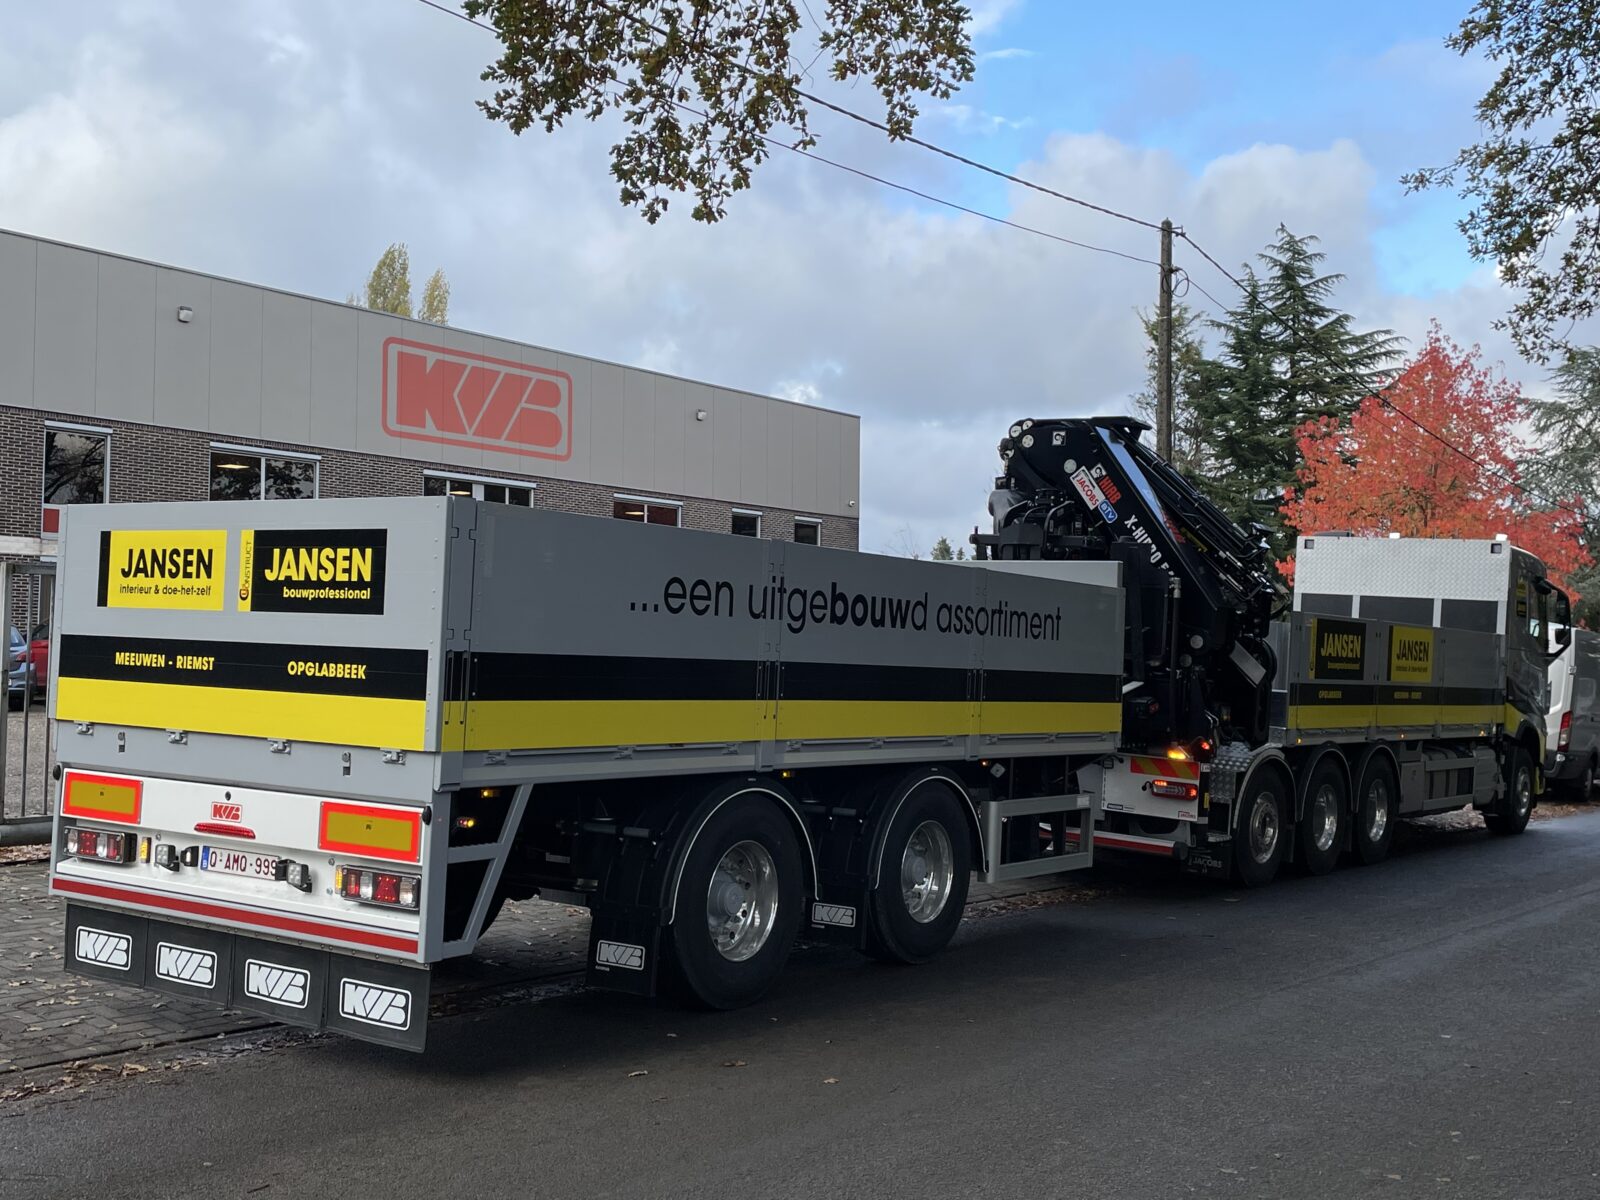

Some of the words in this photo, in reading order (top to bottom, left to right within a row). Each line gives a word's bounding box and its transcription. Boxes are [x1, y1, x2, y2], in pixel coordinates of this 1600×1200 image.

[1076, 477, 1100, 506] JACOBS
[1100, 502, 1115, 519] BTV
[120, 547, 214, 580] JANSEN
[264, 547, 373, 582] JANSEN
[119, 583, 153, 595] interieur
[153, 584, 160, 595] &
[162, 584, 212, 597] doe-het-zelf
[282, 586, 371, 601] bouwprofessional
[748, 575, 929, 635] uitgebouwd
[936, 600, 1062, 641] assortiment
[1320, 631, 1361, 659] JANSEN
[1396, 639, 1430, 663] JANSEN
[115, 652, 166, 668] MEEUWEN
[175, 655, 215, 671] RIEMST
[287, 660, 367, 680] OPGLABBEEK
